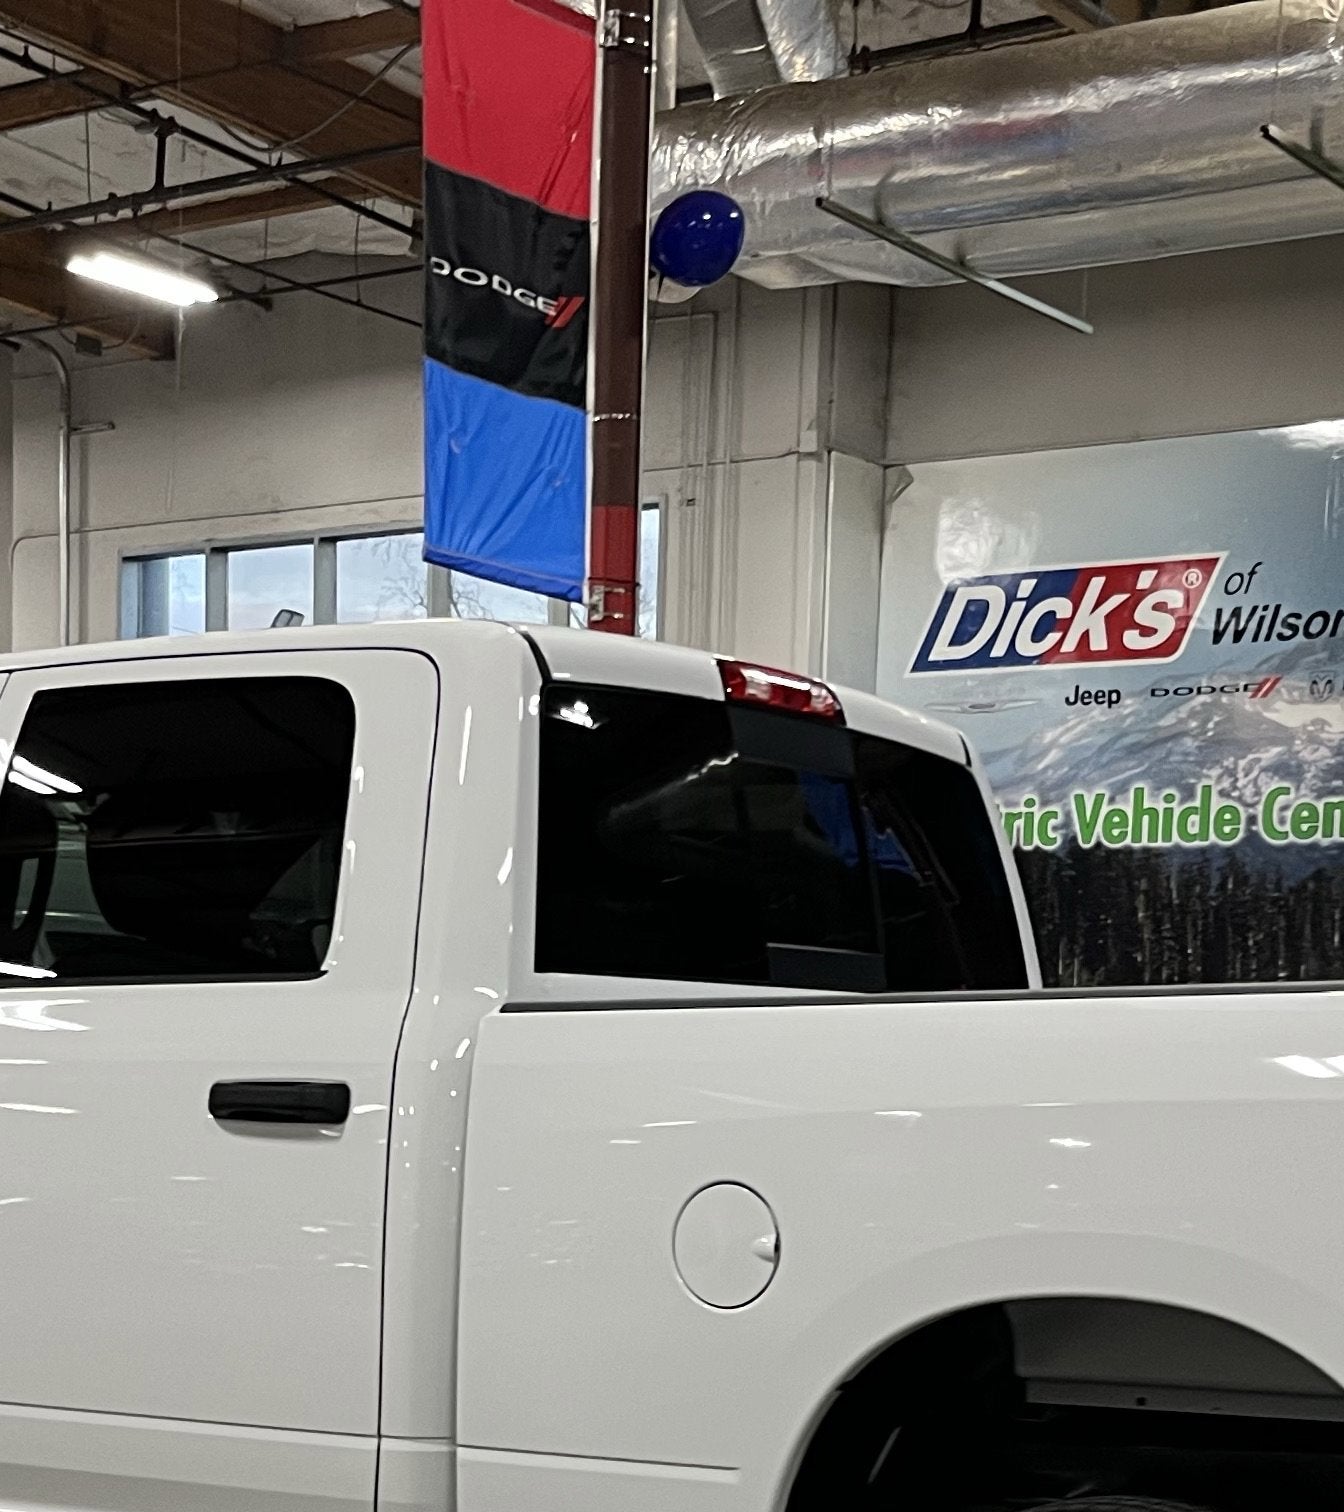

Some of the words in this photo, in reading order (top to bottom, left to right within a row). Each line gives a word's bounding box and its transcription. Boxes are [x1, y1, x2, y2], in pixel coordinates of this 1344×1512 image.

[429, 256, 559, 317] DODGE
[927, 569, 1184, 663] Dick's
[1223, 561, 1263, 597] of
[1064, 684, 1122, 709] Jeep
[1150, 681, 1259, 699] DODGE
[997, 797, 1058, 847] ric
[1073, 784, 1242, 845] Vehicle
